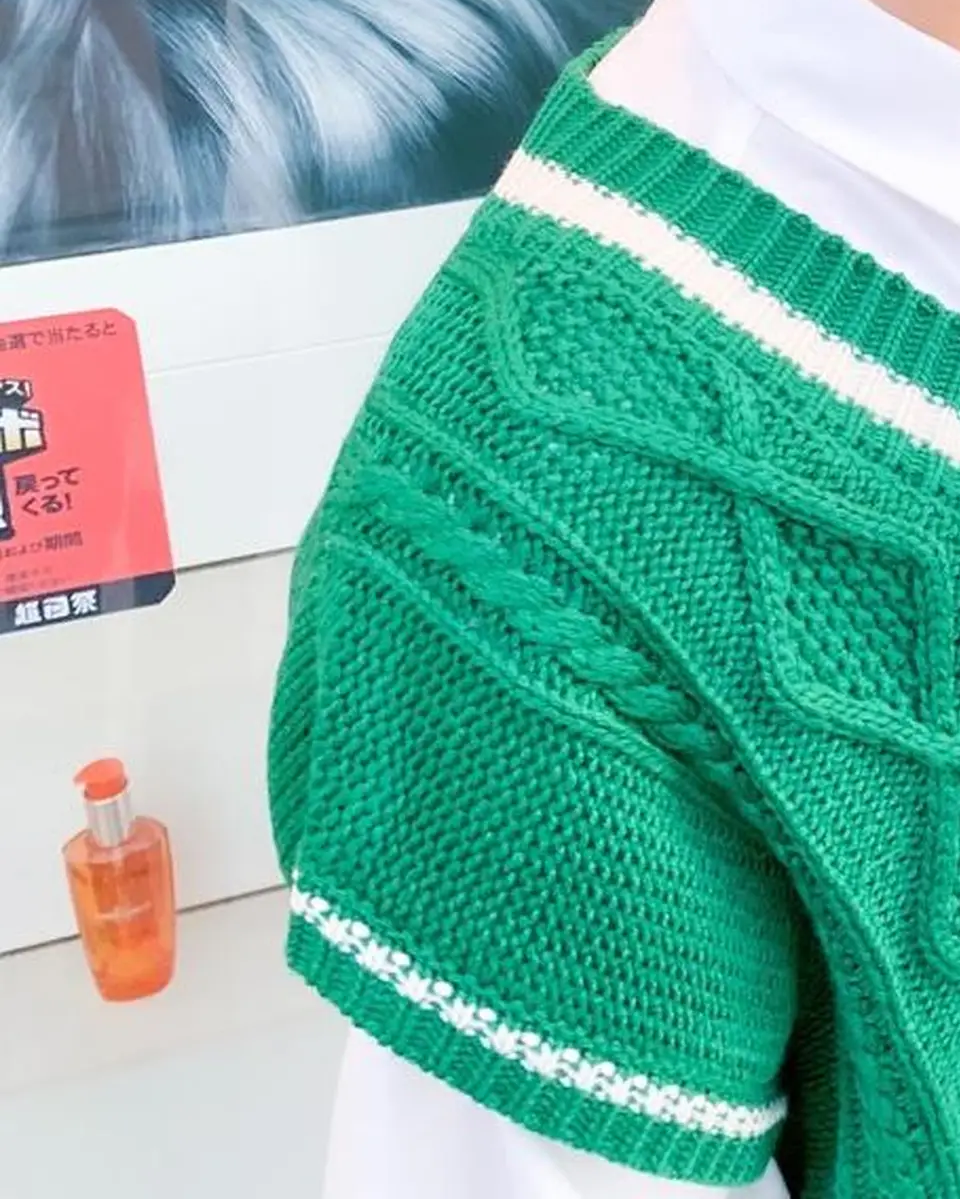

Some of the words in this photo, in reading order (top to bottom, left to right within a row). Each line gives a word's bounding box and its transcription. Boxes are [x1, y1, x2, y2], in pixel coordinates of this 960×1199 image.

[0, 381, 31, 397] ス!
[13, 467, 81, 496] 戻って
[22, 492, 73, 516] くる!
[0, 531, 83, 558] および期間
